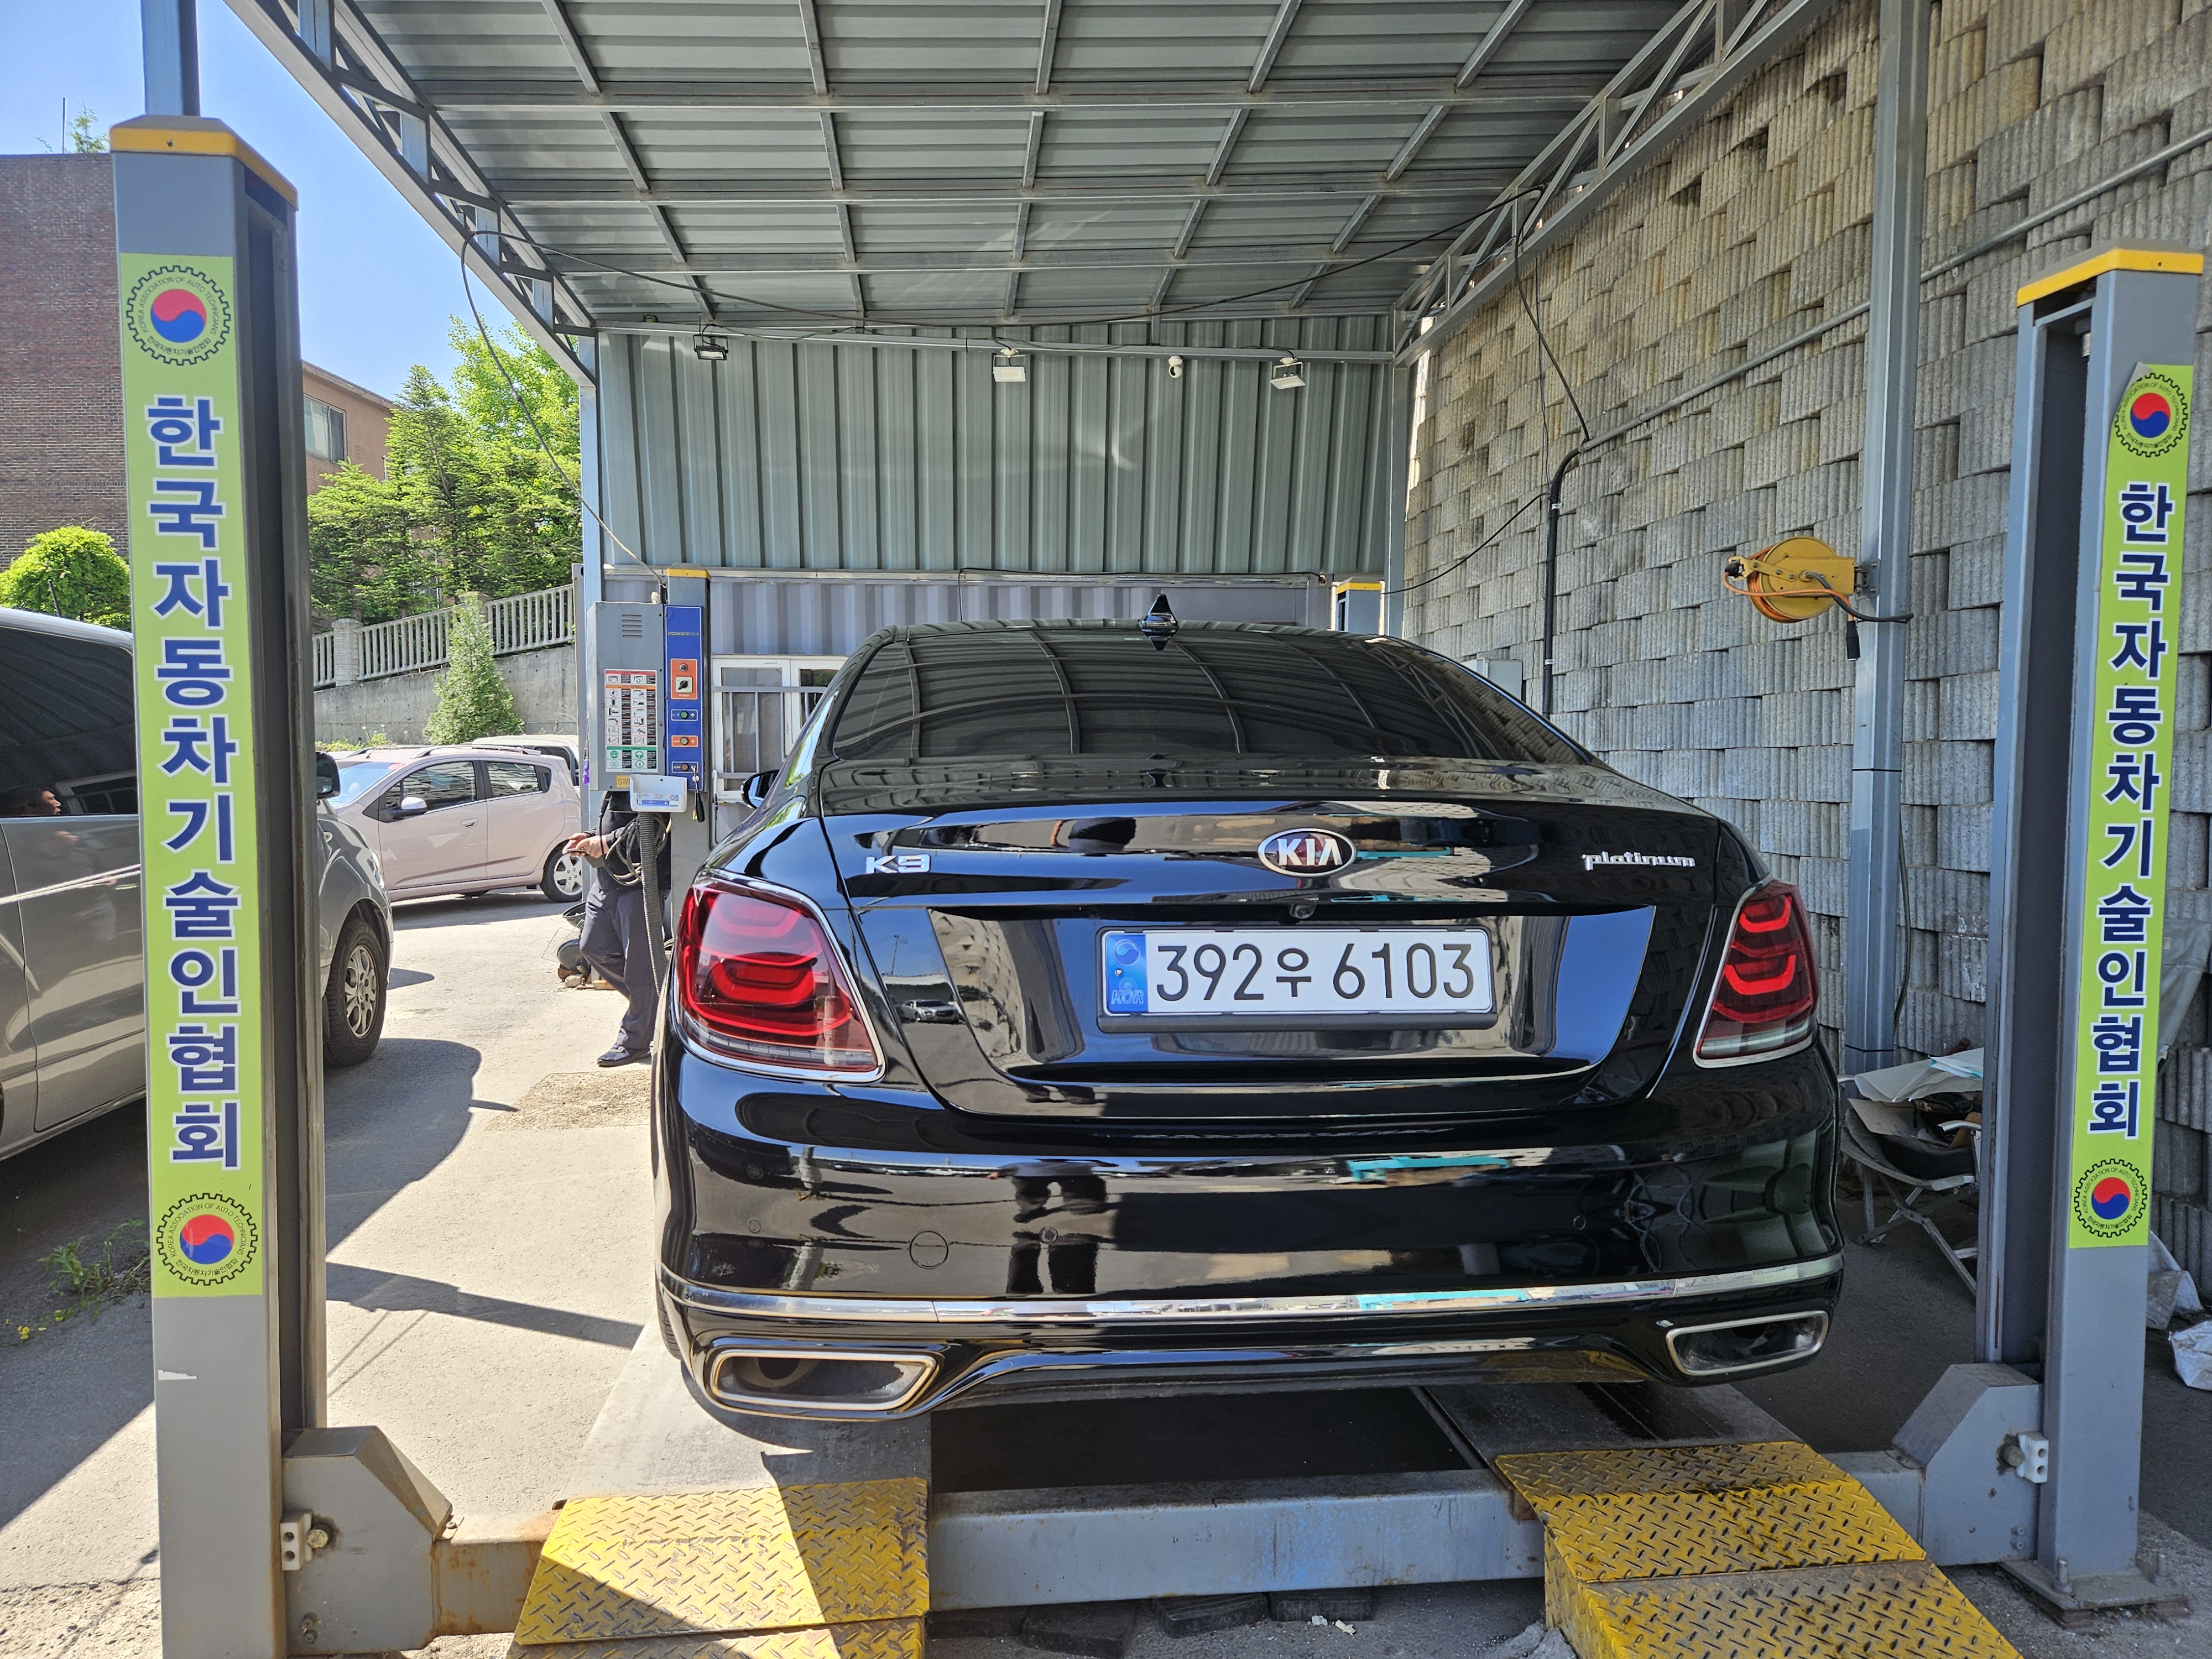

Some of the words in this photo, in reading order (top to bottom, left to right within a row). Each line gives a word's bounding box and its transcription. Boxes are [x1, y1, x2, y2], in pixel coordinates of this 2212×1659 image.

[139, 277, 174, 308] ASSOCIATION
[186, 279, 205, 293] AUTO
[138, 309, 149, 333] KOREA
[205, 291, 220, 336] TECHNICIANS
[2158, 385, 2172, 396] AUTO
[147, 396, 242, 1168] 한국자동차기술인협회
[2091, 483, 2173, 1138] 한국자동차기술인협회
[866, 854, 931, 874] K9
[1277, 838, 1343, 866] KIA
[1582, 851, 1695, 871] platinum
[1111, 989, 1145, 1005] KOR
[2084, 1167, 2110, 1194] ASSOCIATION
[2118, 1170, 2132, 1179] AUTO
[169, 1204, 204, 1234] ASSOCIATION
[216, 1204, 234, 1217] AUTO
[168, 1235, 177, 1257] KOREA
[233, 1215, 247, 1255] TECHNICIANS
